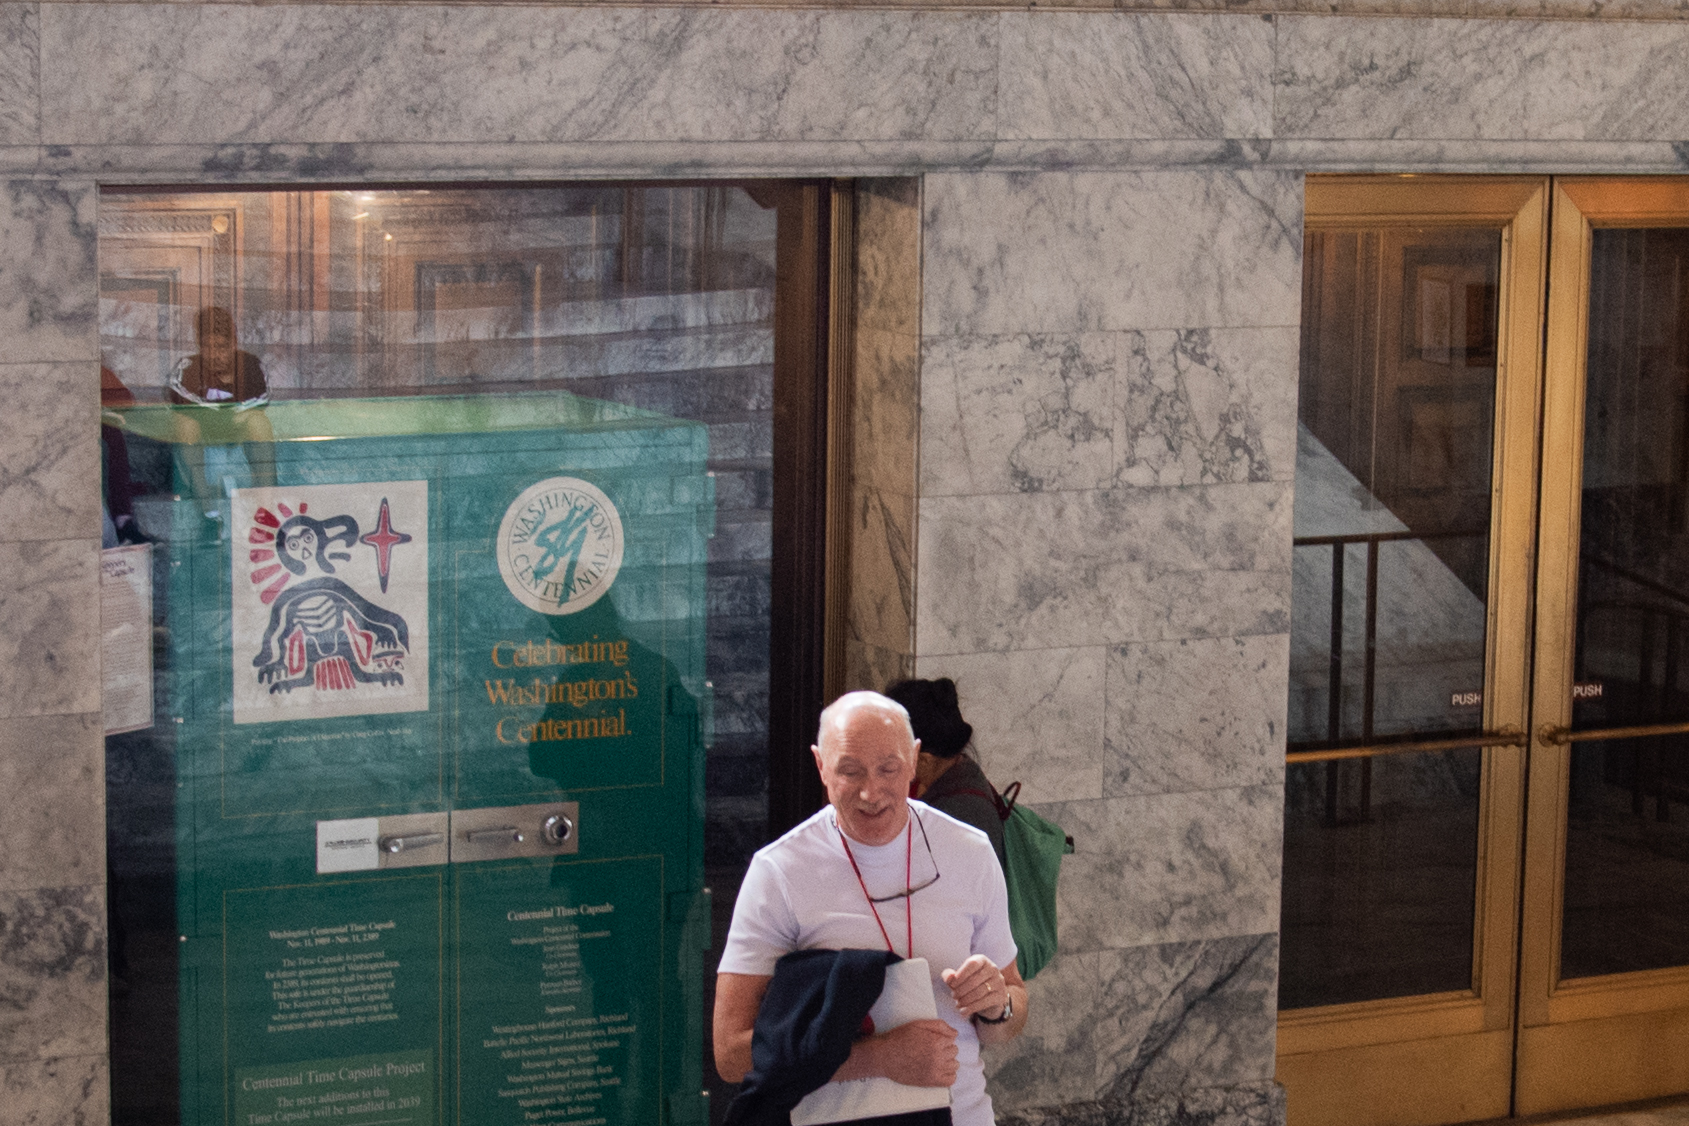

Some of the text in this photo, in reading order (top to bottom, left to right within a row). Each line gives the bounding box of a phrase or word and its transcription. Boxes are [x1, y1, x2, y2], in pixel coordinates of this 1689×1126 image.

[513, 492, 610, 545] WASHINGTON
[514, 549, 610, 598] CENTENNIAL
[491, 634, 629, 669] Celebrating
[485, 670, 639, 708] Washington's
[1452, 693, 1482, 706] PUSH
[1573, 684, 1603, 698] PUSH
[495, 708, 632, 745] Centennial.
[507, 902, 614, 921] Centennial Time Capsule
[242, 1061, 425, 1091] Centennial Time Capsule Project
[276, 1086, 390, 1107] The next additions to this
[247, 1113, 272, 1125] Time
[274, 1108, 311, 1123] Capsule
[313, 1105, 330, 1117] will
[333, 1104, 344, 1115] be
[346, 1100, 385, 1114] installed
[387, 1101, 396, 1110] in
